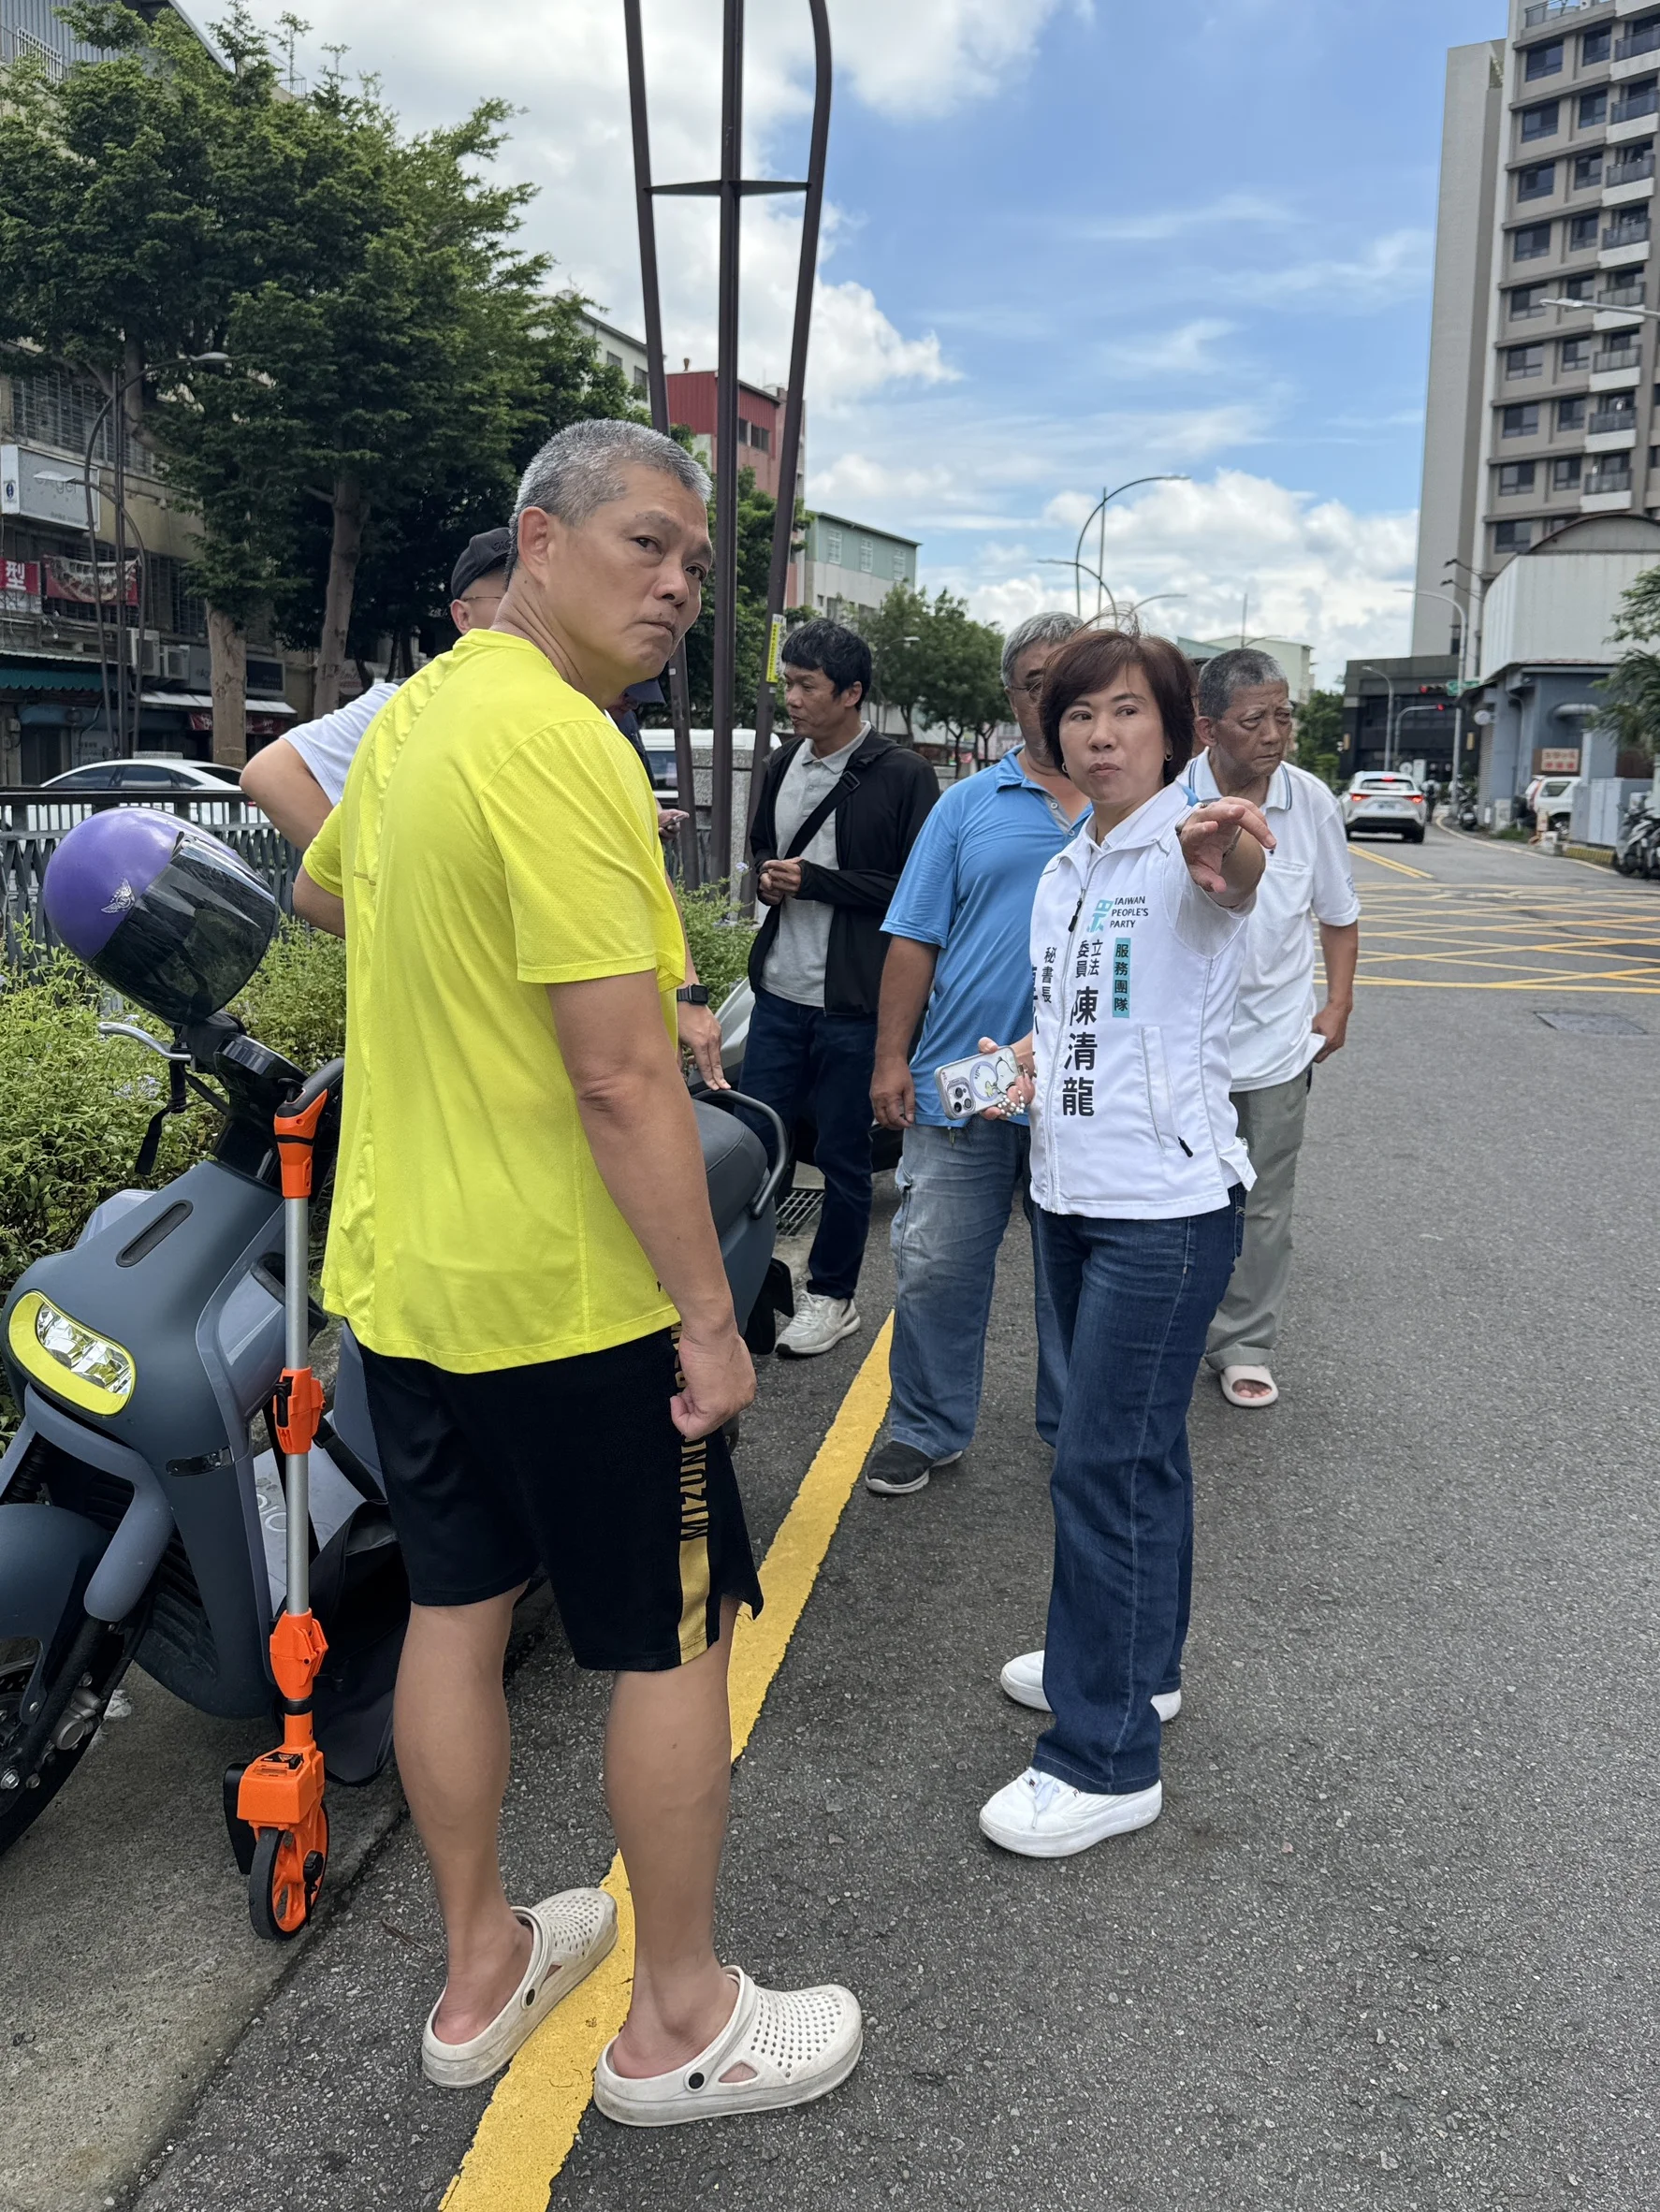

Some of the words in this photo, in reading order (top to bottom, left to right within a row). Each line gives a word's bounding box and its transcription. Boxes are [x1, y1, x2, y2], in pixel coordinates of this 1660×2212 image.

[1111, 908, 1149, 917] PEOPLE'S
[1114, 895, 1146, 906] TAIWAN
[1110, 919, 1136, 928] PARTY
[1075, 939, 1090, 979] 委員
[1087, 939, 1103, 976] 立法
[1114, 943, 1129, 1011] 服務團隊
[1062, 985, 1099, 1117] 陳清龍
[680, 1437, 709, 1543] MIZUN
